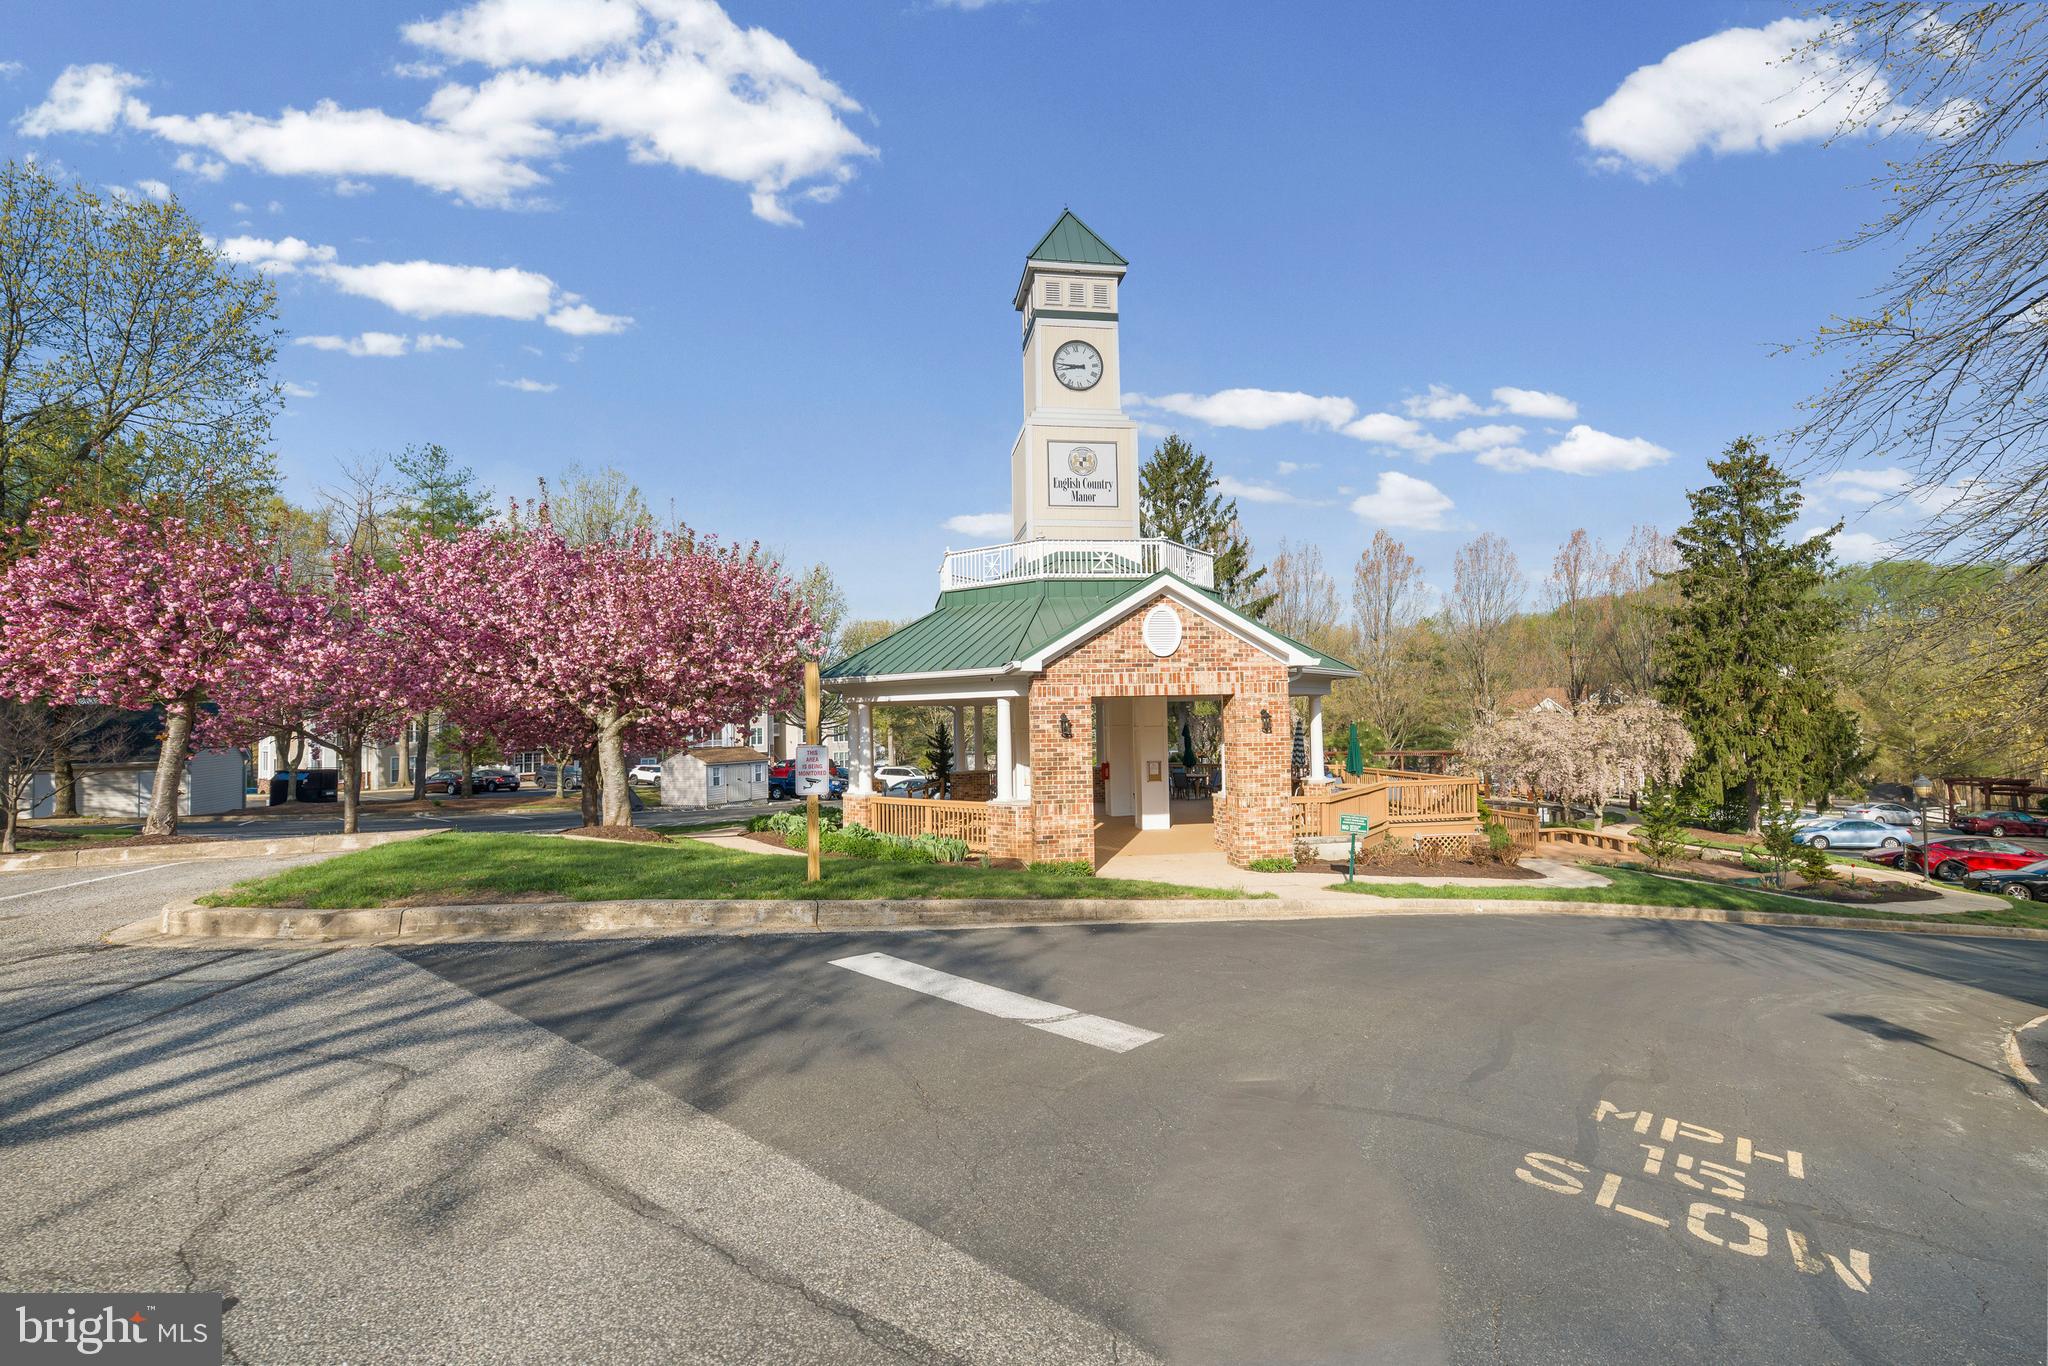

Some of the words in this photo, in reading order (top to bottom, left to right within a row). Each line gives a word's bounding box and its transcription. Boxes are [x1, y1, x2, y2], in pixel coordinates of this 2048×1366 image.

[1053, 477, 1081, 492] English
[1082, 477, 1113, 492] Country
[1071, 490, 1096, 502] Manor
[1591, 1100, 1805, 1179] MPH
[1640, 1144, 1746, 1200] 15
[1514, 1151, 1872, 1294] SLOW
